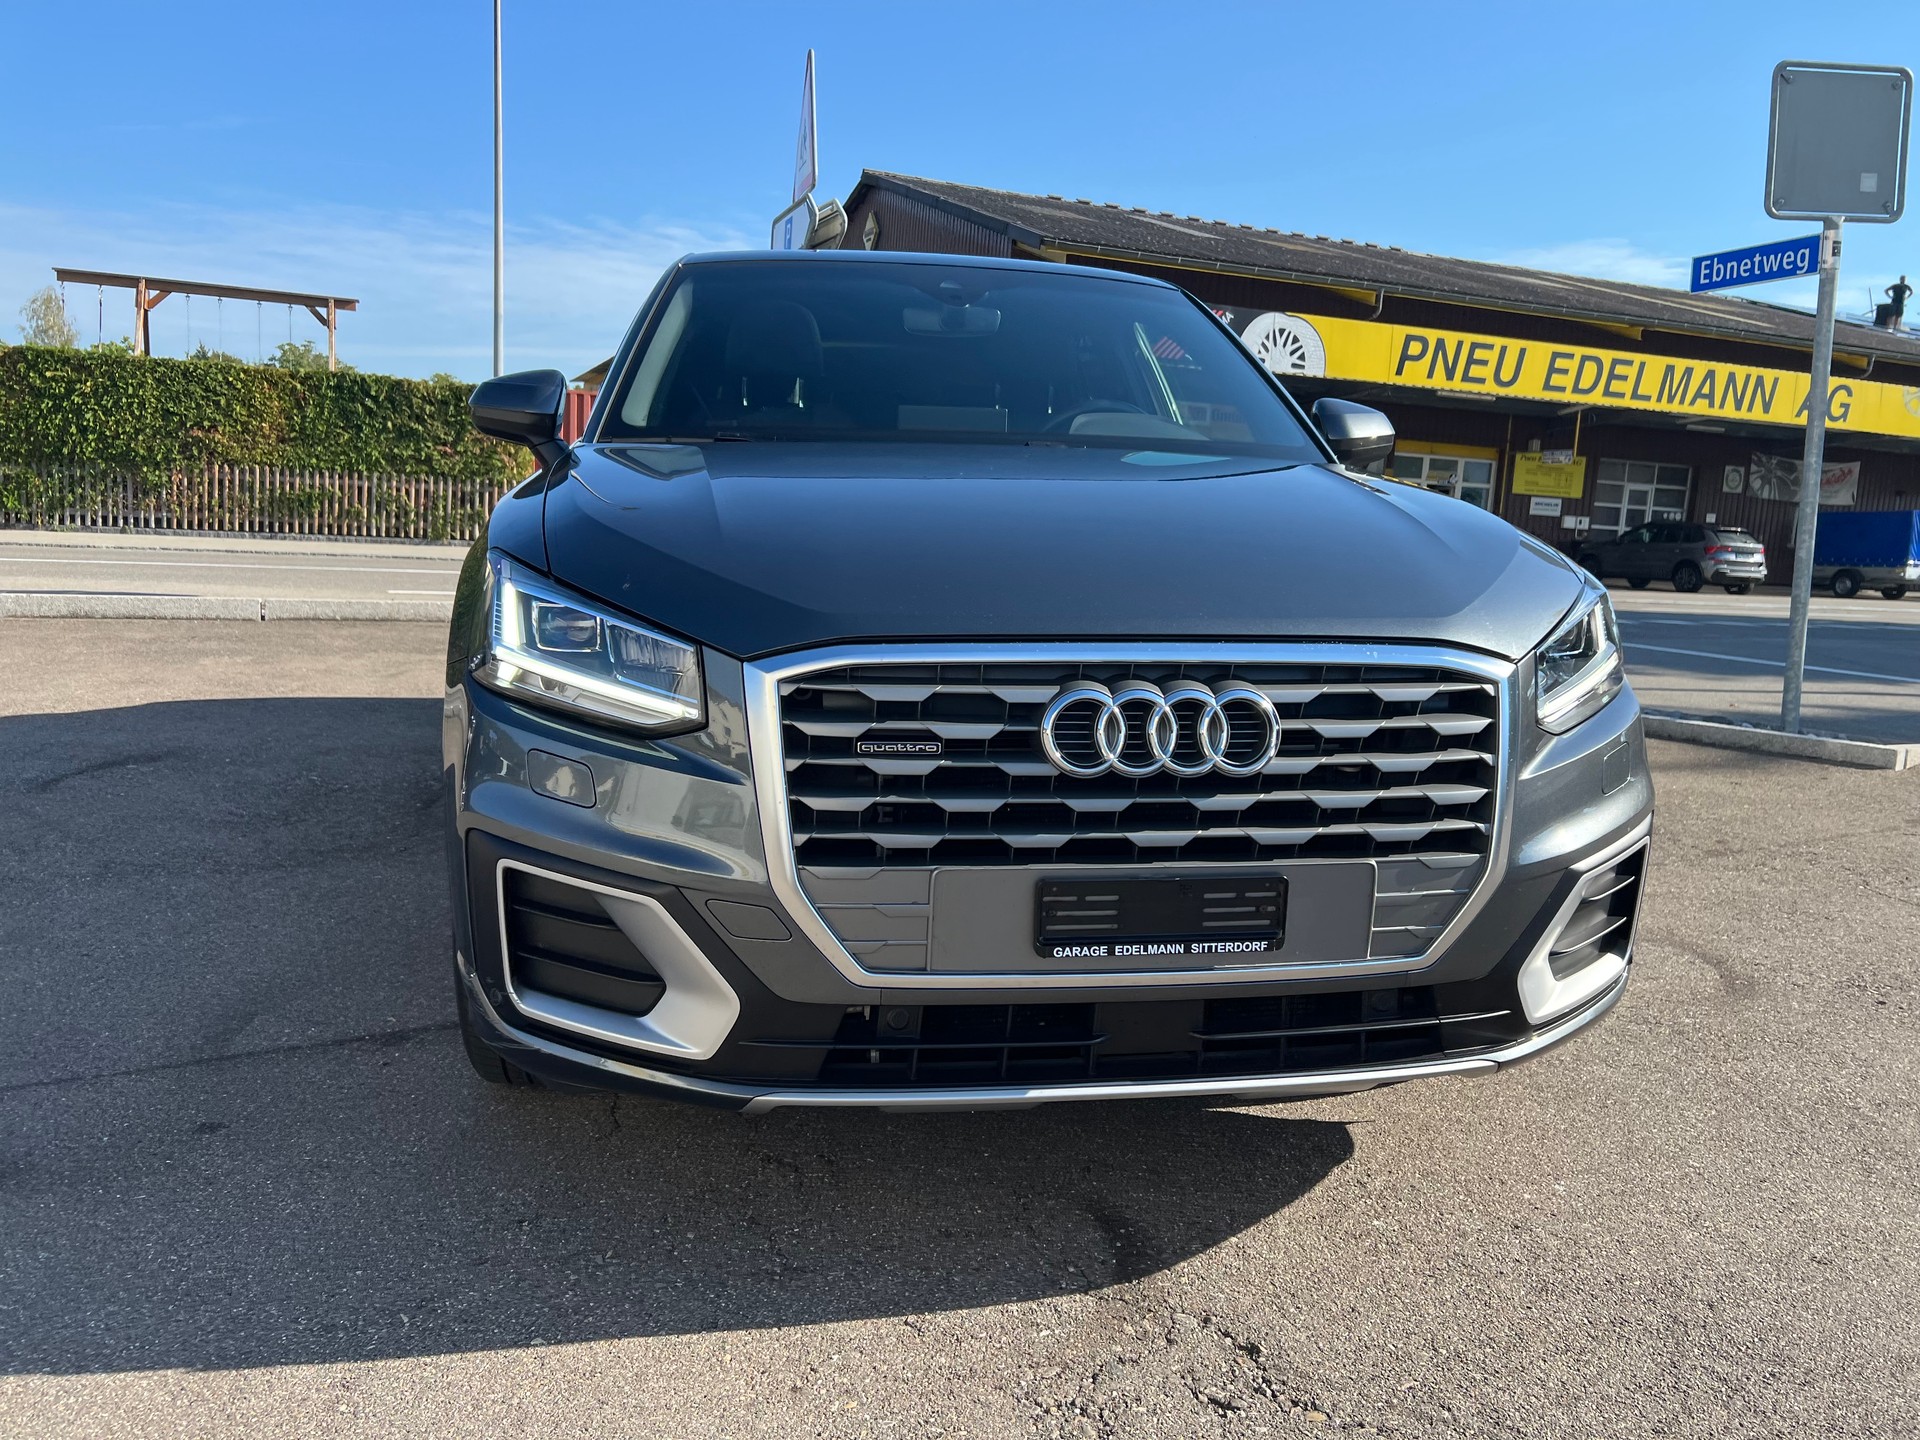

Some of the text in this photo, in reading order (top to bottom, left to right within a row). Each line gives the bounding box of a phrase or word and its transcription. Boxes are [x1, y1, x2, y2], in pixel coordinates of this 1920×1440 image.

[1699, 247, 1811, 284] Ebnetweg
[1395, 334, 1527, 388] PNEU
[1542, 351, 1780, 415] EDELMANN
[861, 743, 938, 753] quattro
[1053, 941, 1269, 958] GARAGE EDELMANN SITTERDORF
